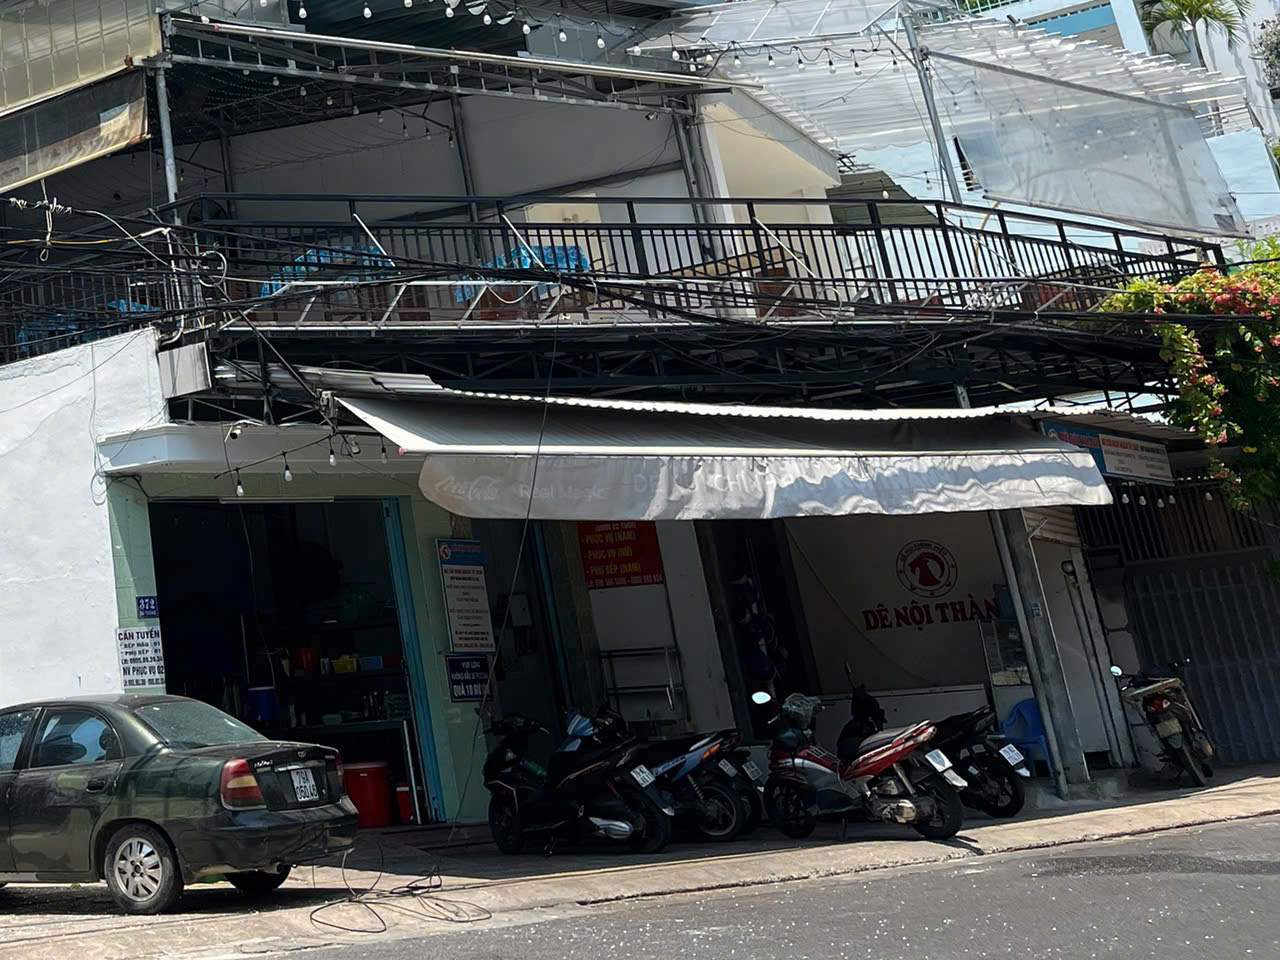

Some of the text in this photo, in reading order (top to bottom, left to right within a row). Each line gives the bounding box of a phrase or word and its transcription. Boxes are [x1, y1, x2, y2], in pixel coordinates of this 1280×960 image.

[139, 598, 156, 610] 372
[862, 593, 1001, 632] DÊ NỘI THÀN
